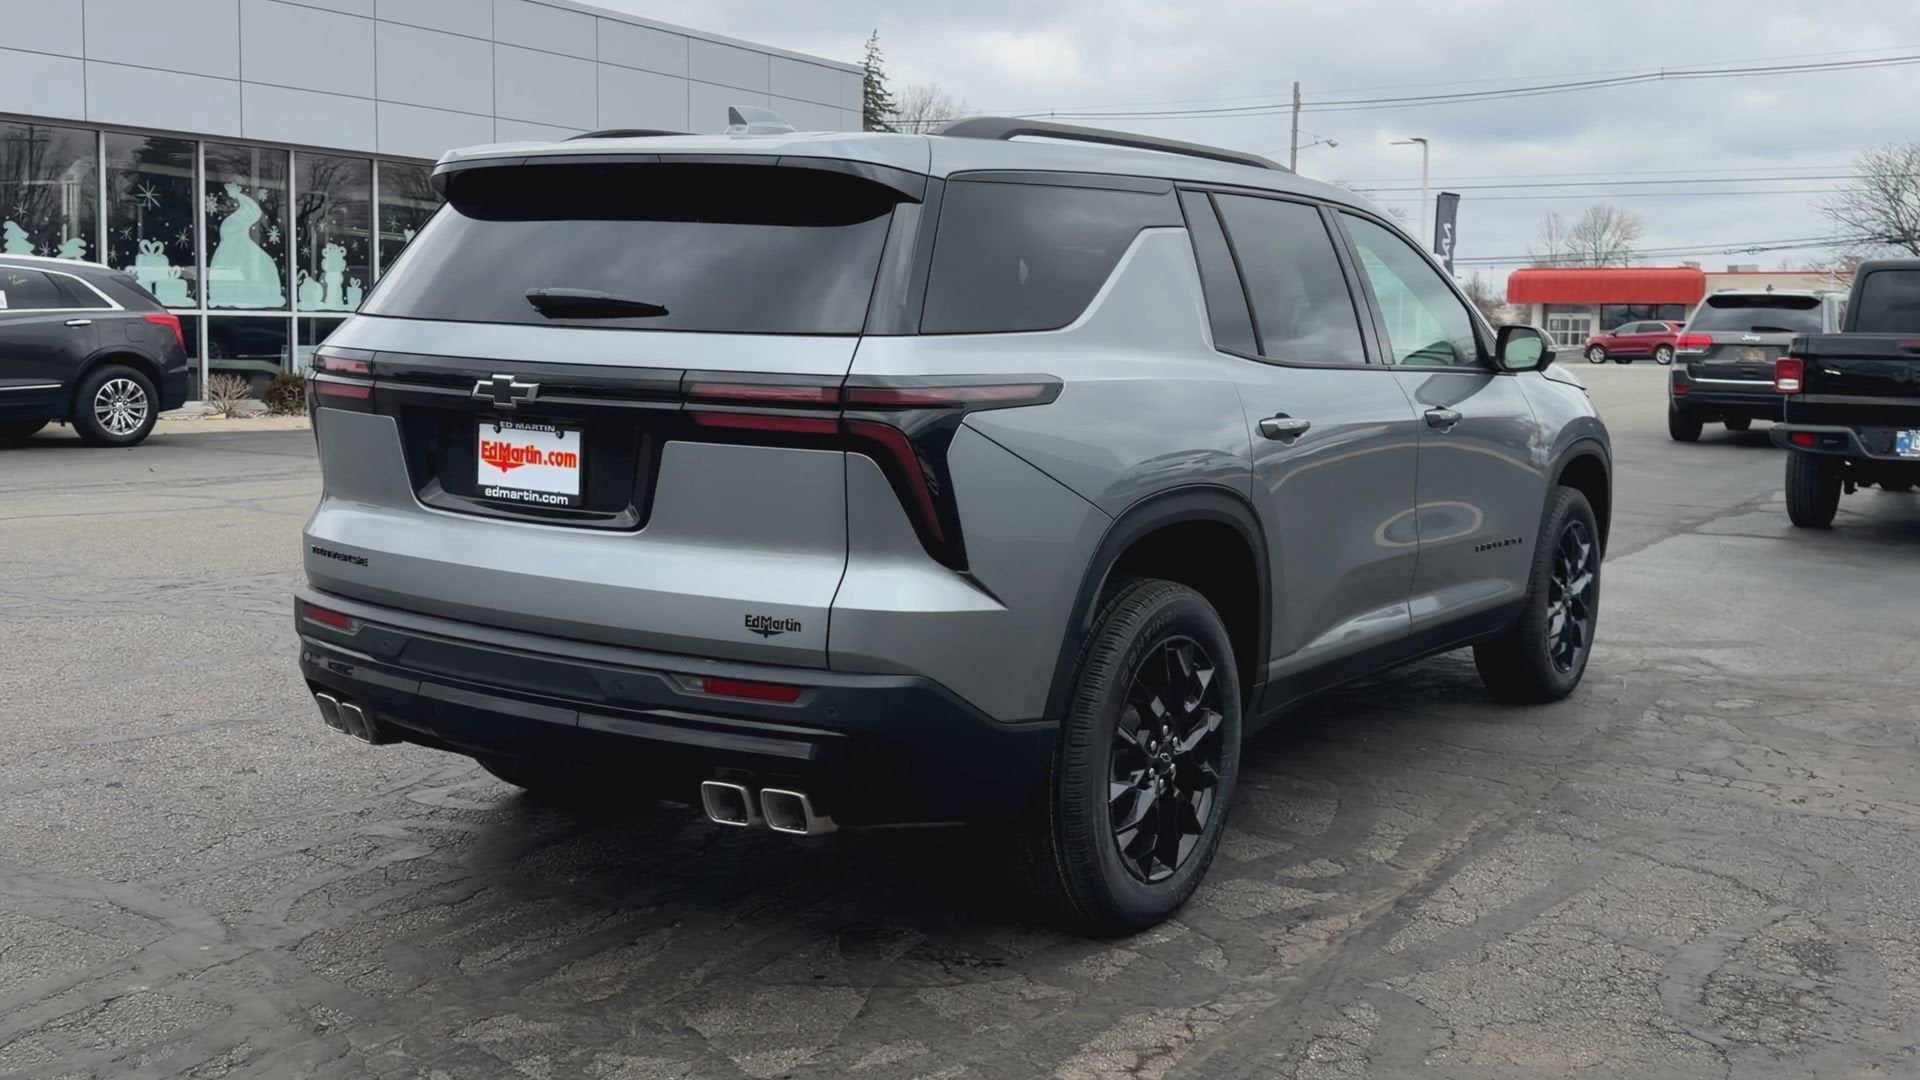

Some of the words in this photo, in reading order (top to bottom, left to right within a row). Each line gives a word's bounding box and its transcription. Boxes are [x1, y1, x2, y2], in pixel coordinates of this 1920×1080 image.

[1741, 333, 1761, 341] Jeep
[500, 420, 513, 428] ED
[515, 422, 556, 432] MARTIN
[481, 440, 577, 468] EdMartin.com
[485, 486, 569, 505] edmartin.com
[745, 614, 802, 632] EdMartin
